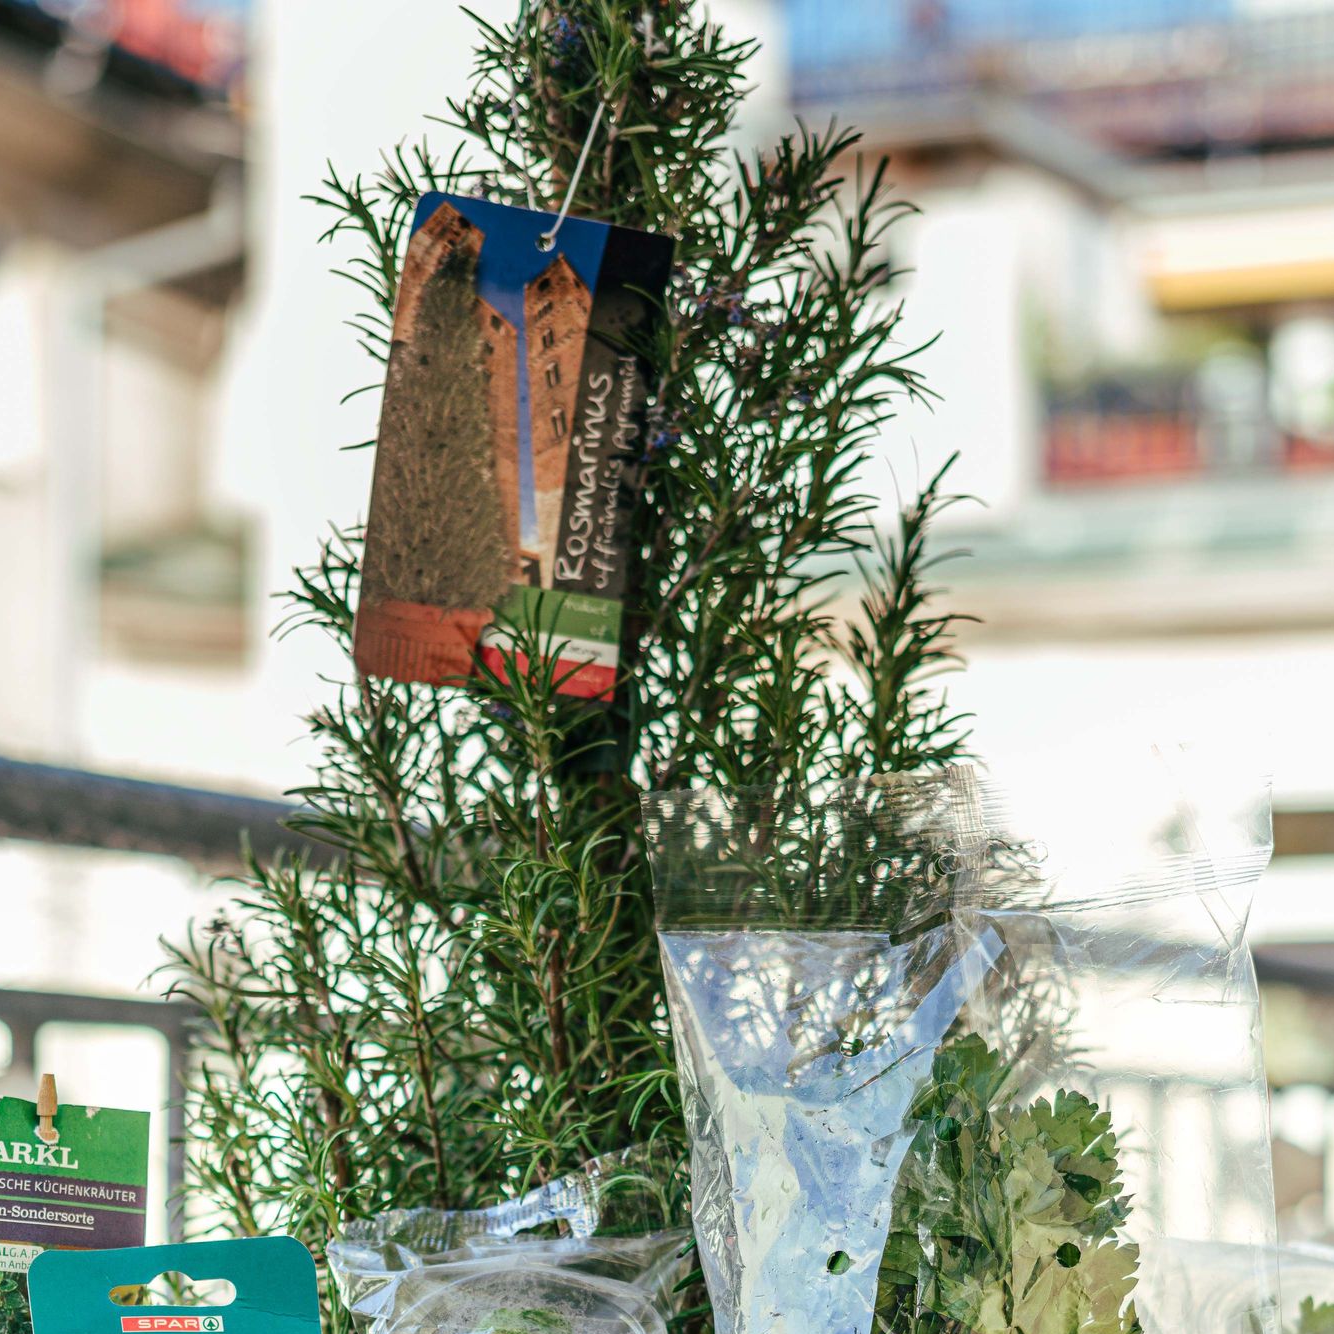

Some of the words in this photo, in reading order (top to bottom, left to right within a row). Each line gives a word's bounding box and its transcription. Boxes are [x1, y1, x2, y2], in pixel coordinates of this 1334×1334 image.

[554, 372, 613, 581] Rosmarinus
[34, 1180, 136, 1202] KÜCHENKRÄUTER
[137, 1318, 199, 1329] SPAR
